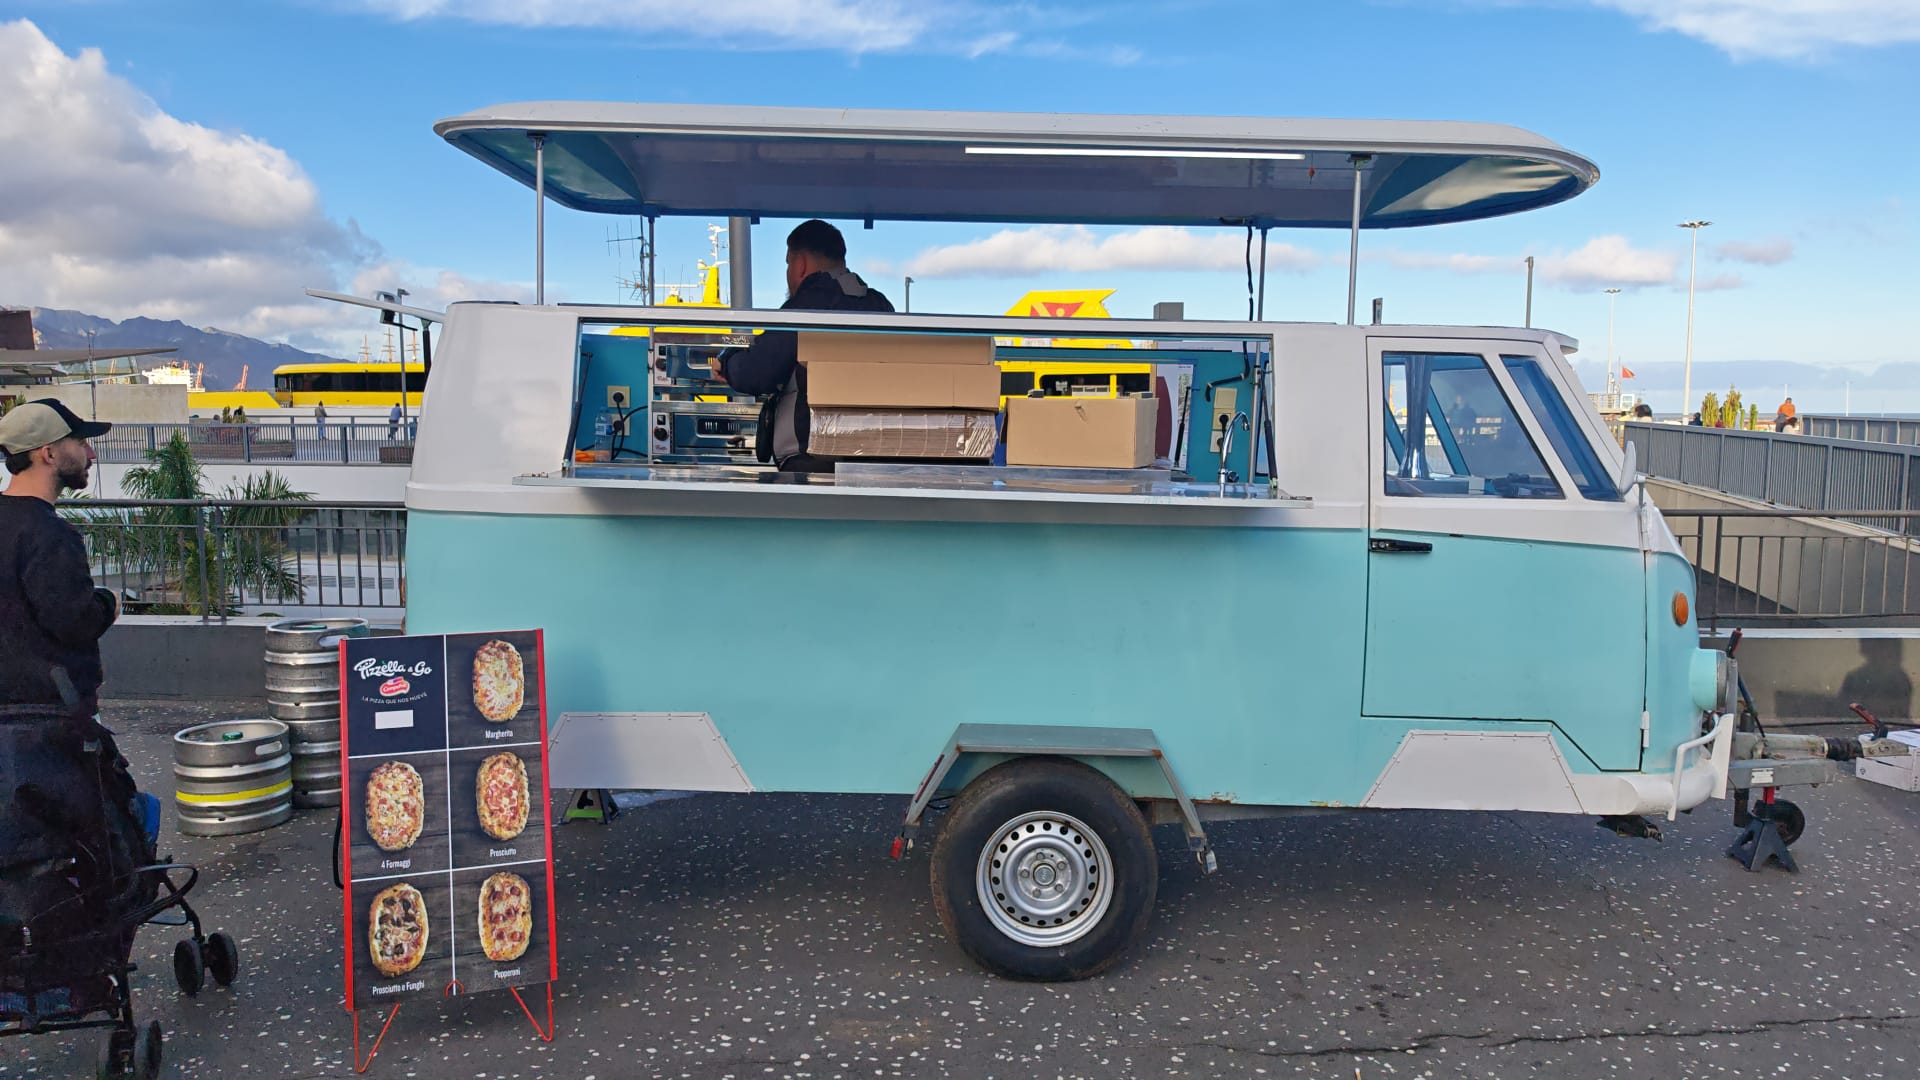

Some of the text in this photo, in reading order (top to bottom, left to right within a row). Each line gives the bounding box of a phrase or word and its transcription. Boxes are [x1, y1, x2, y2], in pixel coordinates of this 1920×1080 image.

[412, 661, 432, 676] Go
[410, 692, 428, 702] MUEVE
[485, 729, 514, 740] Margherita
[490, 848, 517, 858] Prosciutto
[381, 858, 411, 870] 4 Formaggi
[494, 967, 521, 979] Pepperoni
[372, 980, 425, 996] Prosciutto e Funghi
